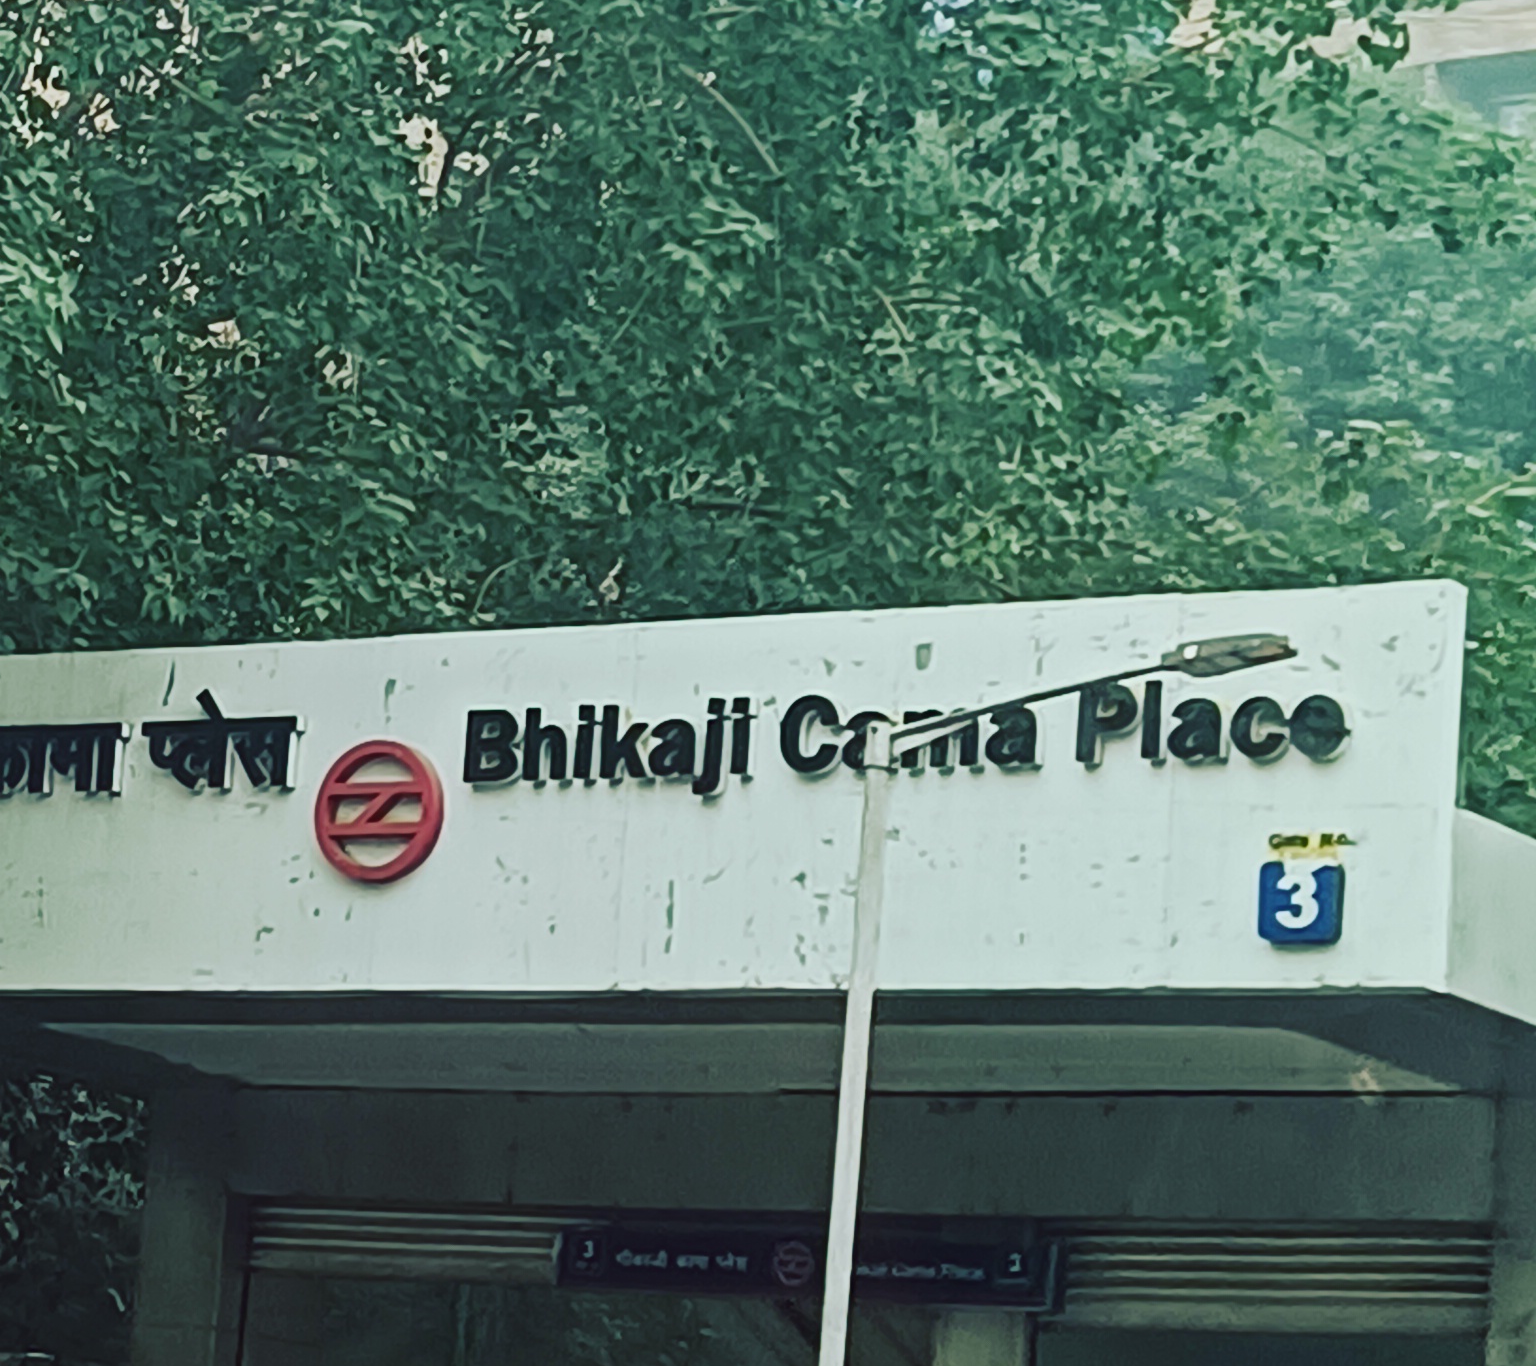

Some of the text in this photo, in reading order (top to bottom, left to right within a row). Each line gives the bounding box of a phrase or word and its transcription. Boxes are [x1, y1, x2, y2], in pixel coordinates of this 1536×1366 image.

[142, 688, 304, 792] प्लेस
[462, 697, 752, 795] Bhikaji
[1076, 679, 1348, 765] Place
[1275, 870, 1319, 929] 3
